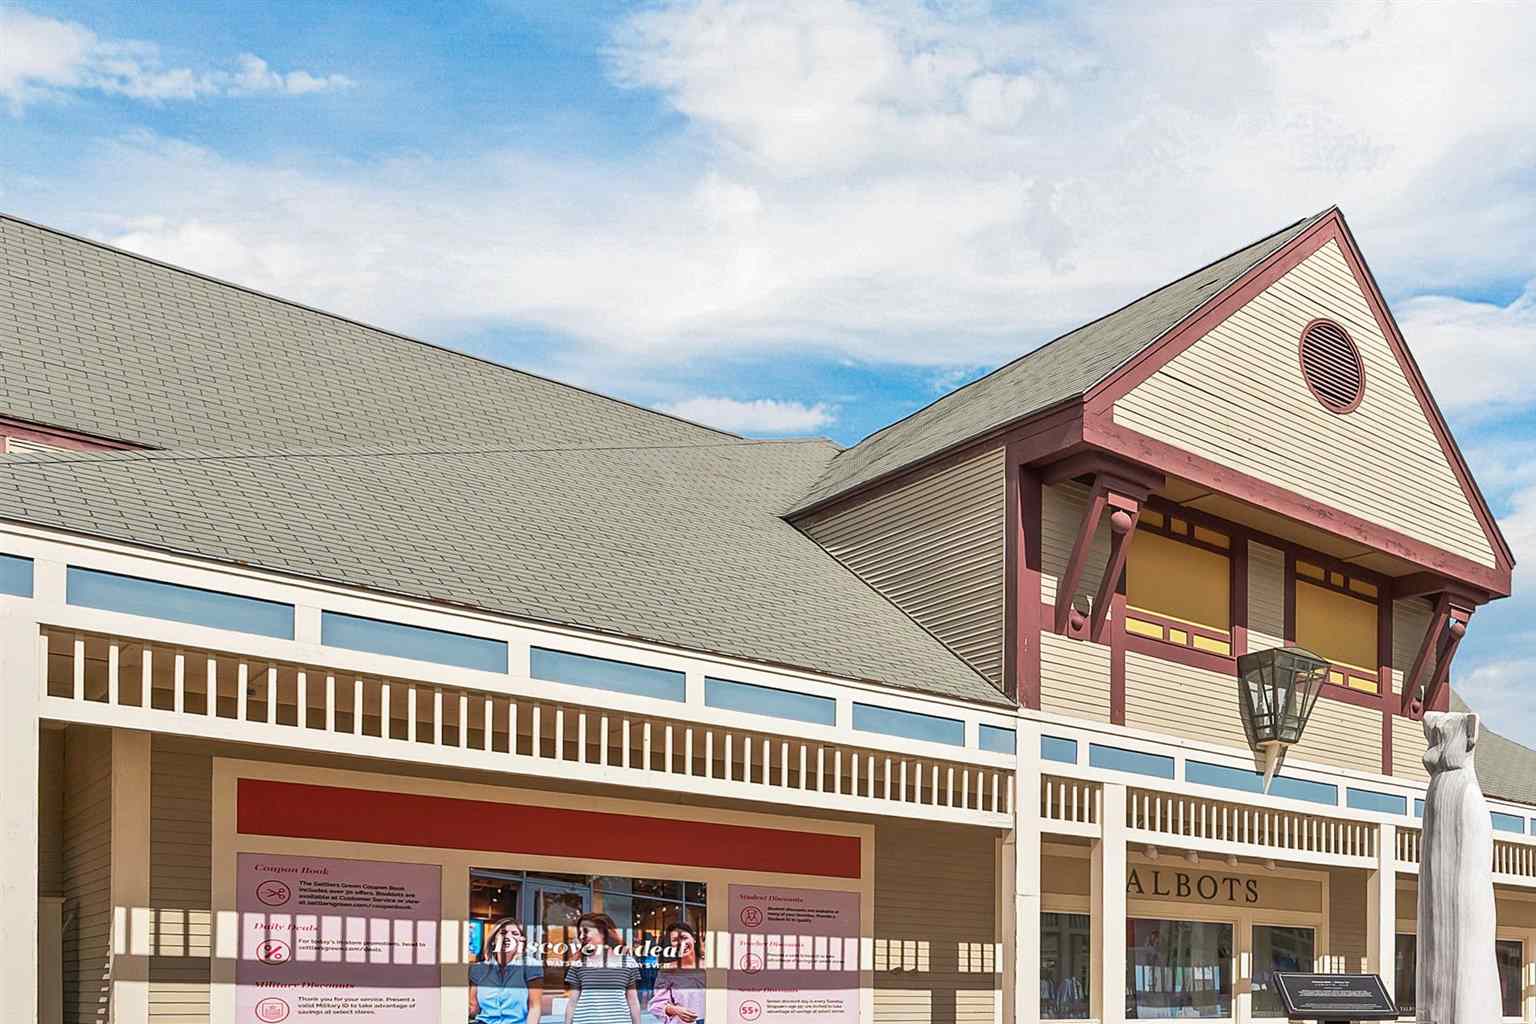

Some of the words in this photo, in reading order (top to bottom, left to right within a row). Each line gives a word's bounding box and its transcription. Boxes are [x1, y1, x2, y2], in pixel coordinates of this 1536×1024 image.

[254, 863, 298, 874] Coupon
[301, 866, 329, 876] Book
[1126, 868, 1258, 903] ALBOTS
[254, 922, 285, 932] Daily
[493, 938, 611, 957] Discover
[635, 940, 690, 958] deal
[741, 1006, 759, 1015] 55+
